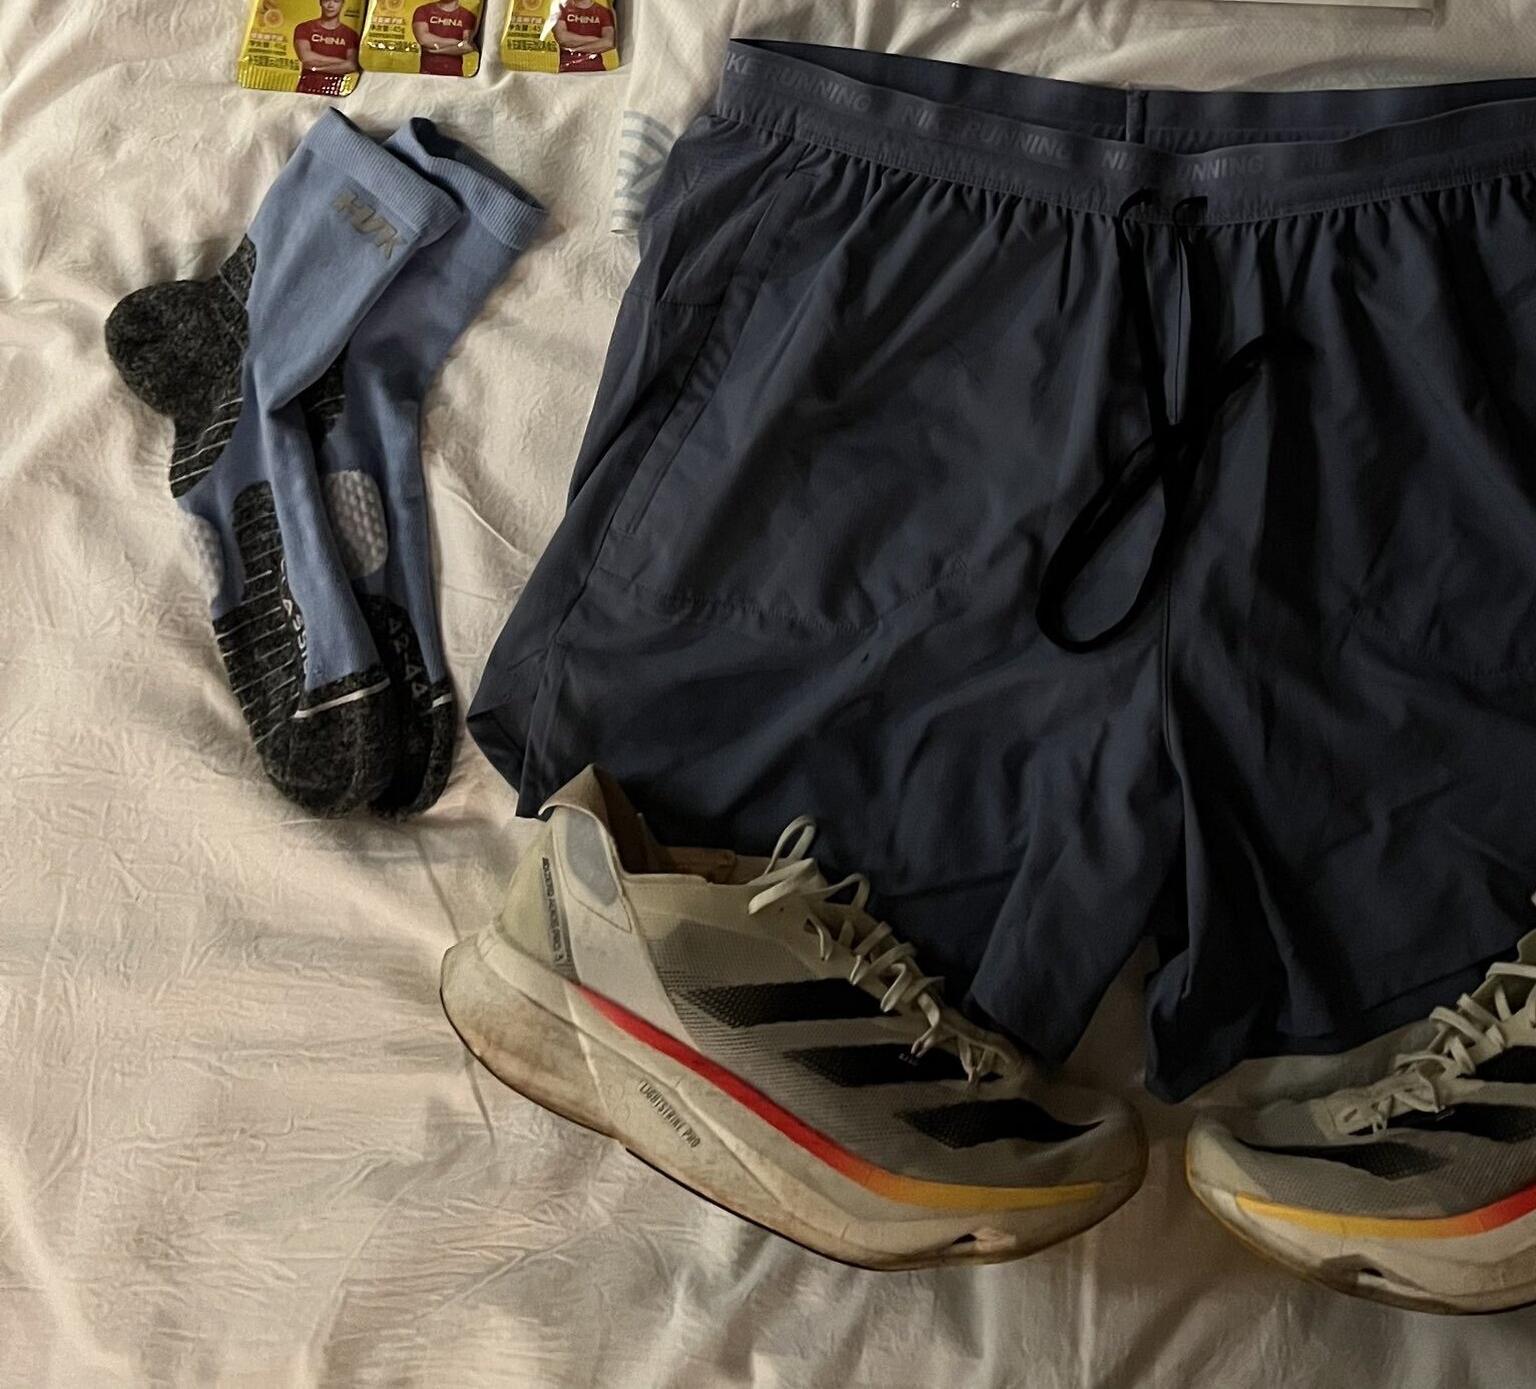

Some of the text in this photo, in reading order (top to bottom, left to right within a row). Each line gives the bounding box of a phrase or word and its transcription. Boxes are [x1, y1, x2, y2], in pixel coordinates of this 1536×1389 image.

[429, 16, 463, 27] CHINA
[567, 14, 600, 24] CHINA
[311, 33, 346, 45] CHINA
